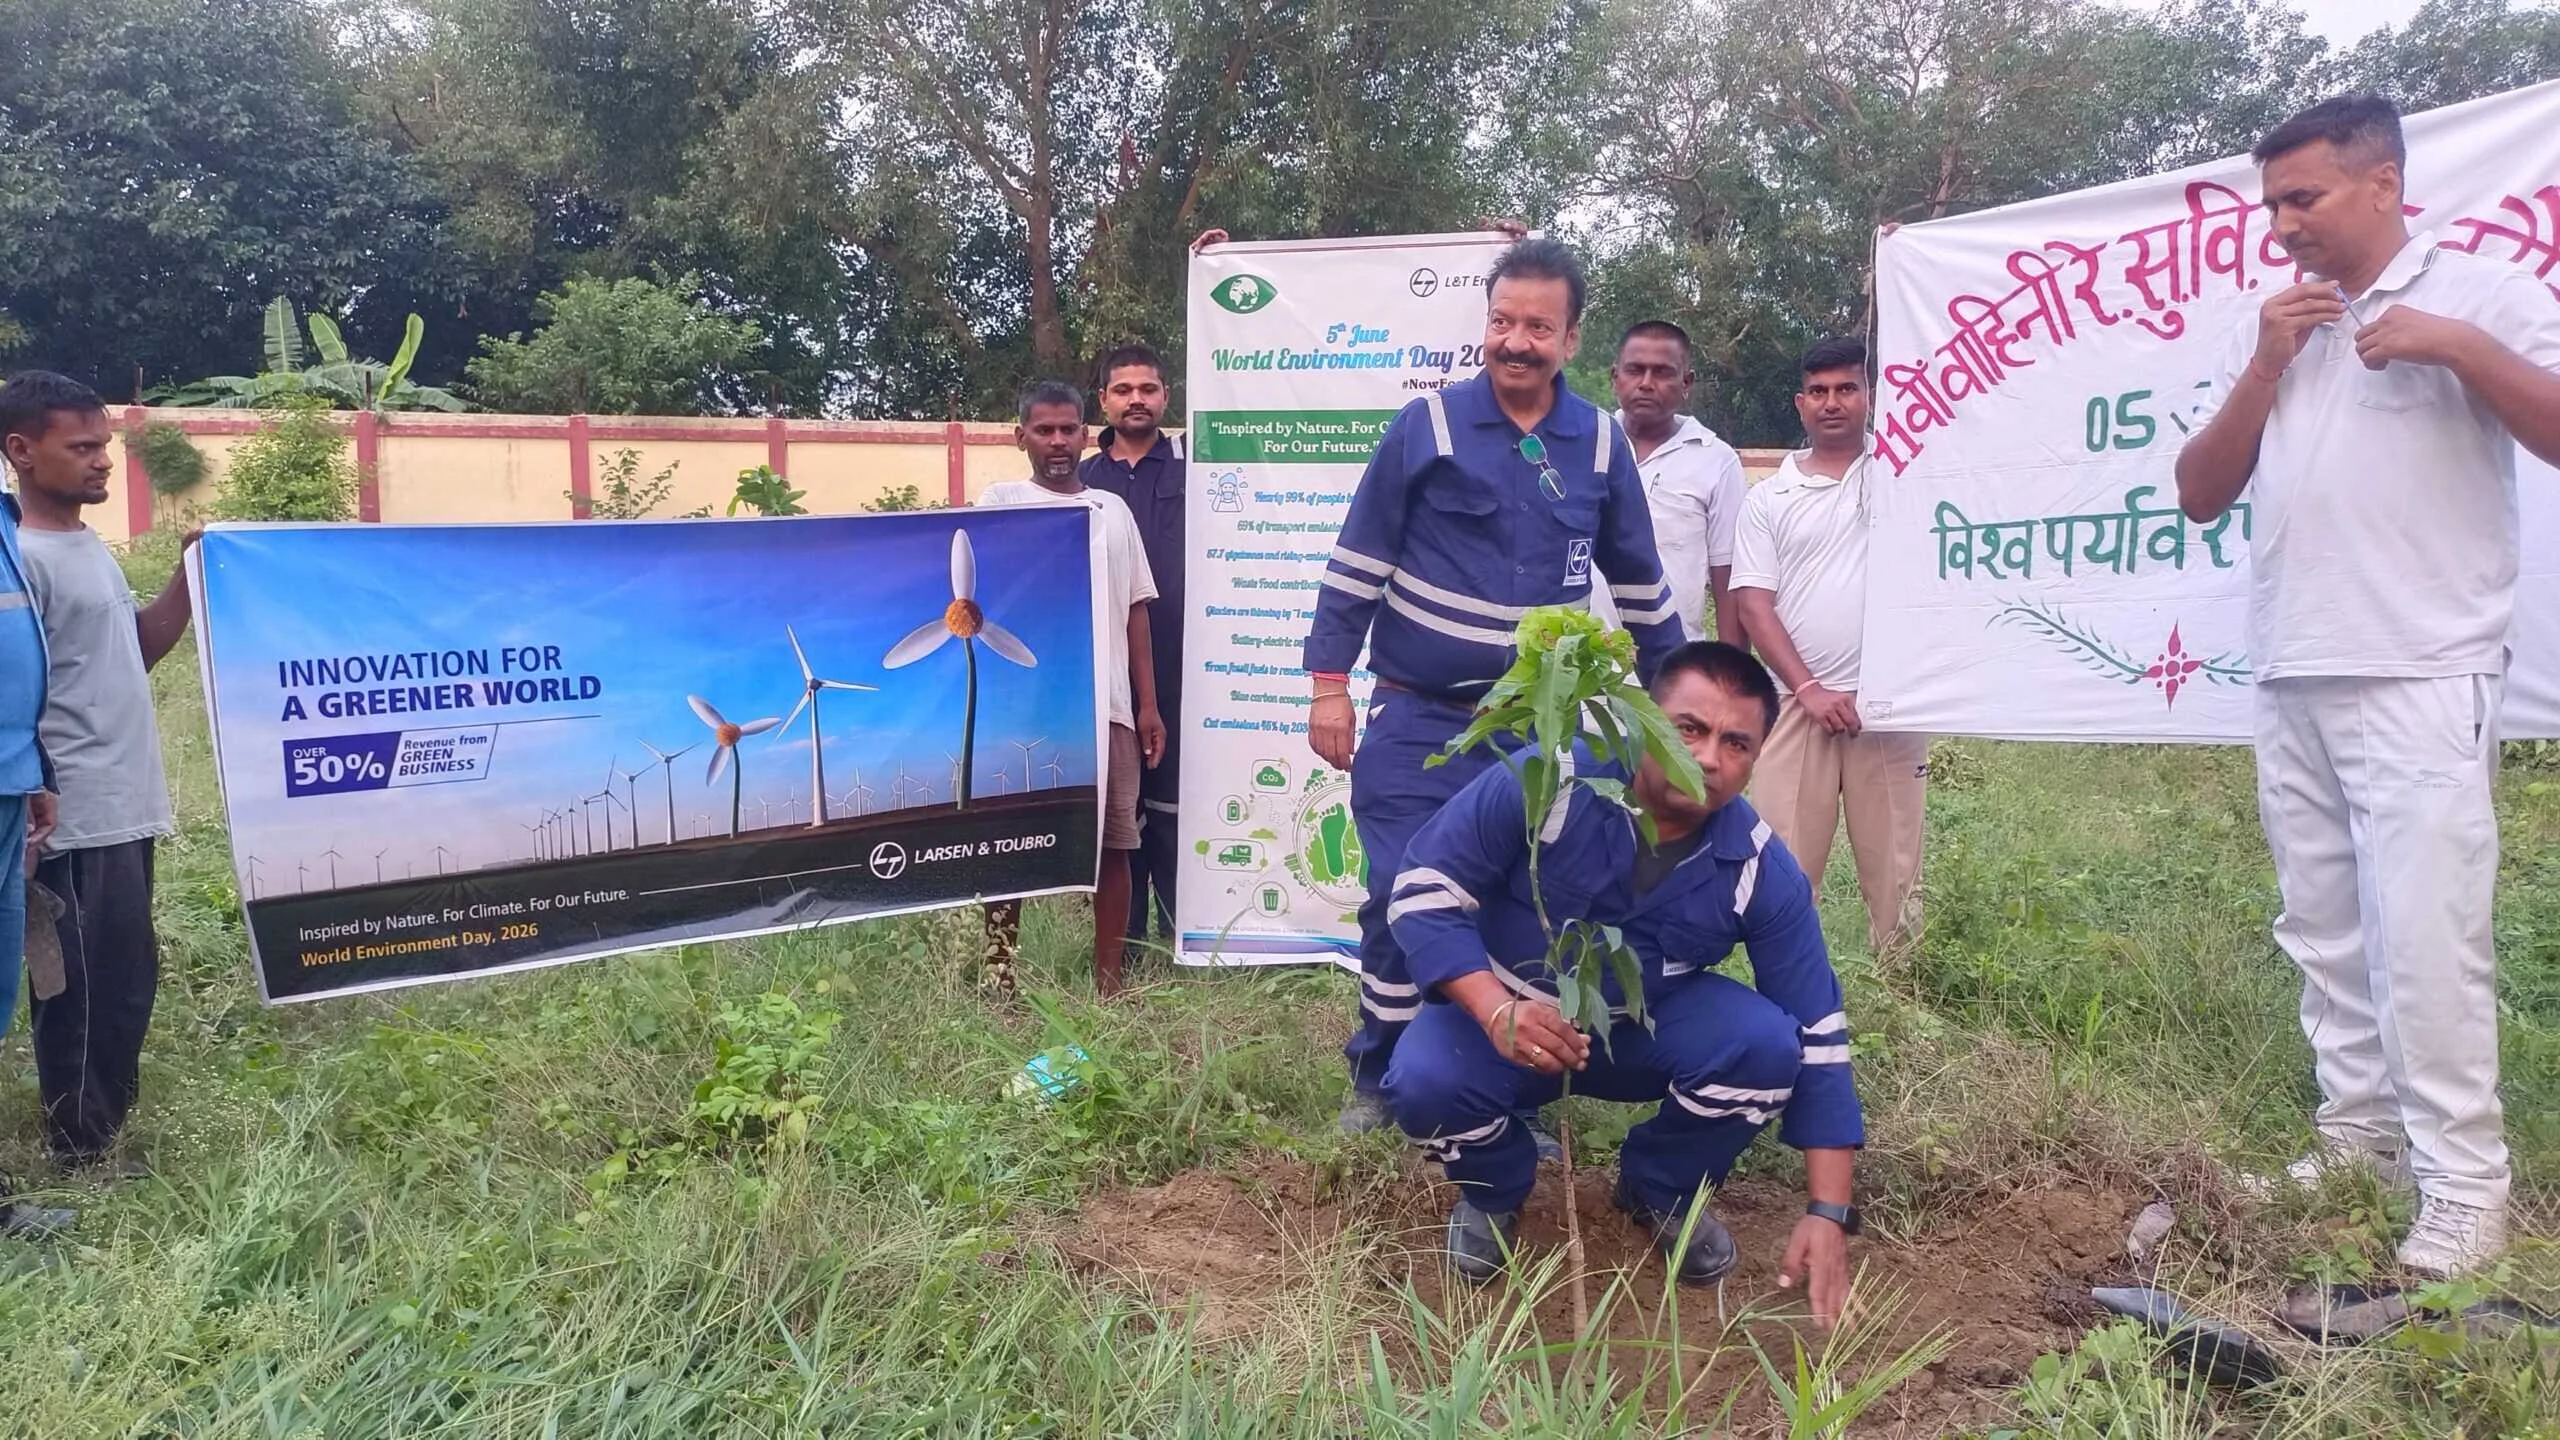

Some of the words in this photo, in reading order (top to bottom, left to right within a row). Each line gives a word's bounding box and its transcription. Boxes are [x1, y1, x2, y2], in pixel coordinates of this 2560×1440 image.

[1445, 275, 1470, 288] L&T
[1472, 275, 1487, 287] En
[1935, 250, 2076, 401] वाहिनी
[1326, 323, 1346, 344] 5th
[1347, 324, 1390, 348] June
[1211, 348, 1274, 371] World
[1277, 347, 1404, 370] Environment
[1408, 345, 1455, 374] Day
[1458, 344, 1486, 367] 20
[1211, 421, 1273, 437] “Inspired
[1275, 421, 1293, 437] by
[1296, 421, 1349, 434] Nature.
[1351, 420, 1376, 434] For
[1378, 420, 1392, 434] C
[2086, 390, 2156, 452] 05
[1263, 440, 1288, 453] For
[1291, 439, 1319, 453] Our
[1321, 440, 1380, 453] Future.”
[1285, 491, 1304, 503] 99%
[1306, 492, 1317, 506] of
[1315, 492, 1345, 506] people
[1256, 520, 1266, 534] of
[1265, 520, 1306, 535] transport
[1930, 501, 2042, 580] विश्व
[1259, 578, 1280, 590] Food
[1282, 609, 1292, 620] by
[279, 649, 489, 688] INNOVATION
[502, 645, 562, 673] FOR
[1204, 661, 1227, 672] From
[1269, 665, 1278, 675] to
[281, 695, 308, 721] A
[318, 683, 475, 718] GREENER
[482, 675, 601, 706] WORLD
[1250, 692, 1278, 704] carbon
[1203, 717, 1219, 729] Cut
[1220, 718, 1260, 731] emissions
[1279, 721, 1290, 736] by
[404, 738, 455, 750] Revenue
[459, 735, 487, 746] from
[293, 747, 327, 759] OVER
[401, 748, 453, 763] GREEN
[294, 751, 385, 786] 50%
[399, 758, 475, 776] BUSINESS
[914, 843, 974, 864] LARSEN
[977, 842, 991, 856] &
[994, 834, 1056, 854] TOUBRO
[299, 919, 360, 941] Inspired
[363, 916, 381, 935] by
[386, 912, 439, 930] Nature.
[443, 908, 465, 922] For
[469, 902, 527, 919] Climate.
[530, 897, 551, 912] For
[555, 894, 580, 908] Our
[584, 889, 629, 905] Future.
[301, 947, 351, 967] World
[356, 934, 458, 960] Environment
[462, 930, 496, 946] Day,
[501, 923, 538, 941] 2026
